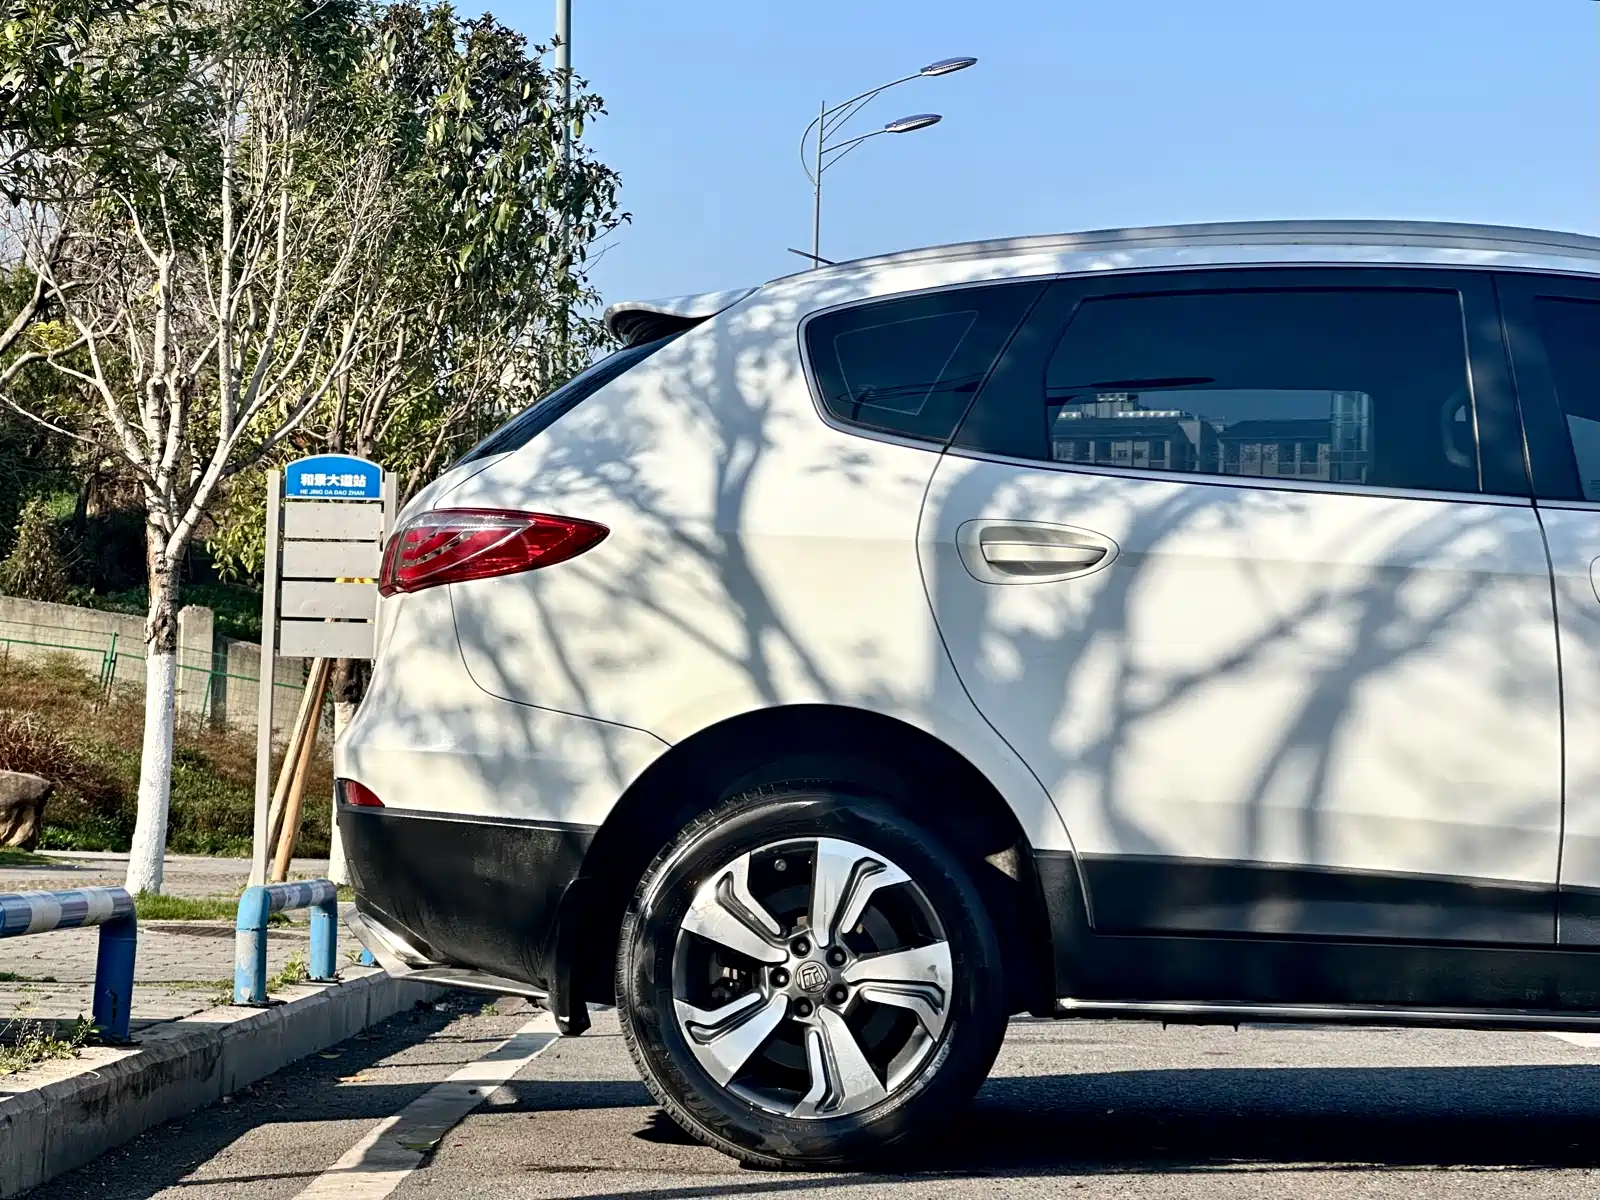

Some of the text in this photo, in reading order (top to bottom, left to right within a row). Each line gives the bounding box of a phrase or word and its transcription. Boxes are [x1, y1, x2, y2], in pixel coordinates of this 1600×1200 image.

[301, 473, 366, 487] 和景大道站
